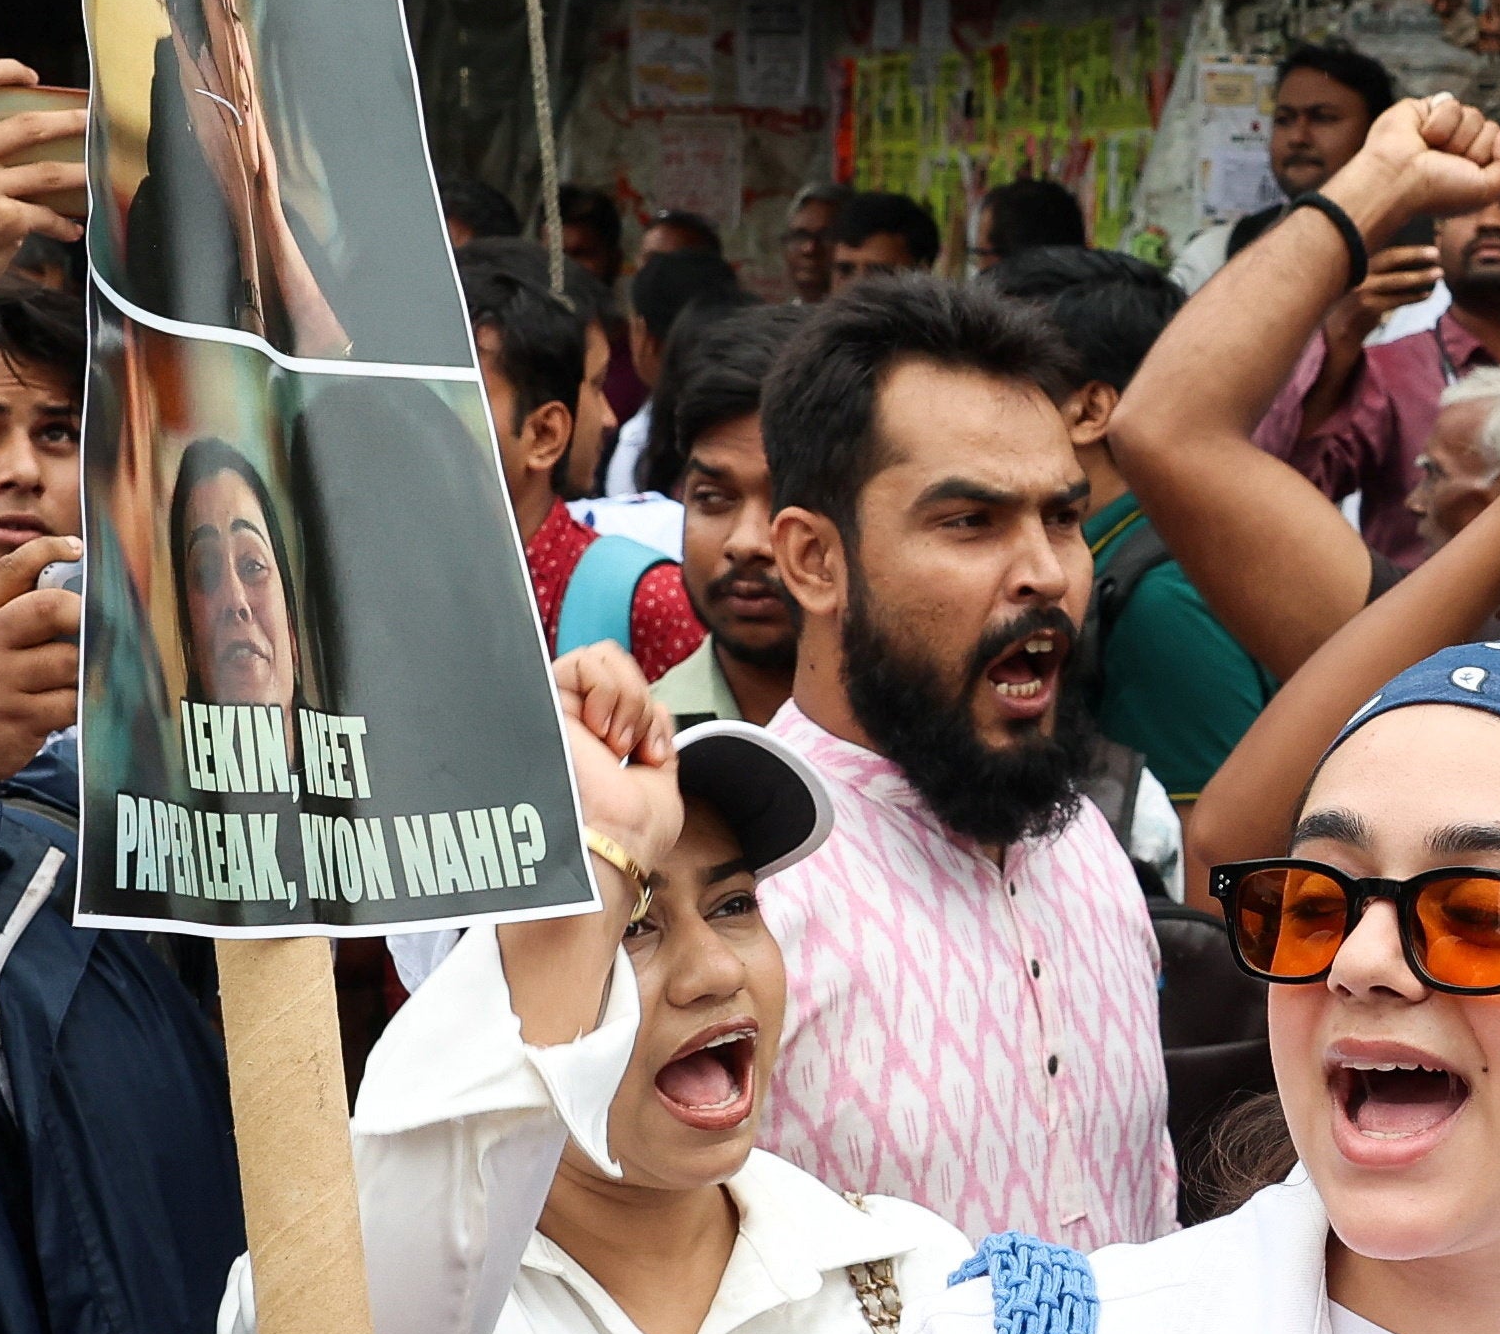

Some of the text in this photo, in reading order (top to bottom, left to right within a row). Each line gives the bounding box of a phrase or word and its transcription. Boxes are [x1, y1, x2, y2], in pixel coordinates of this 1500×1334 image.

[180, 699, 372, 803] LEKIN, NEET
[116, 793, 547, 910] PAPER LEAK, KYON NAHI?
